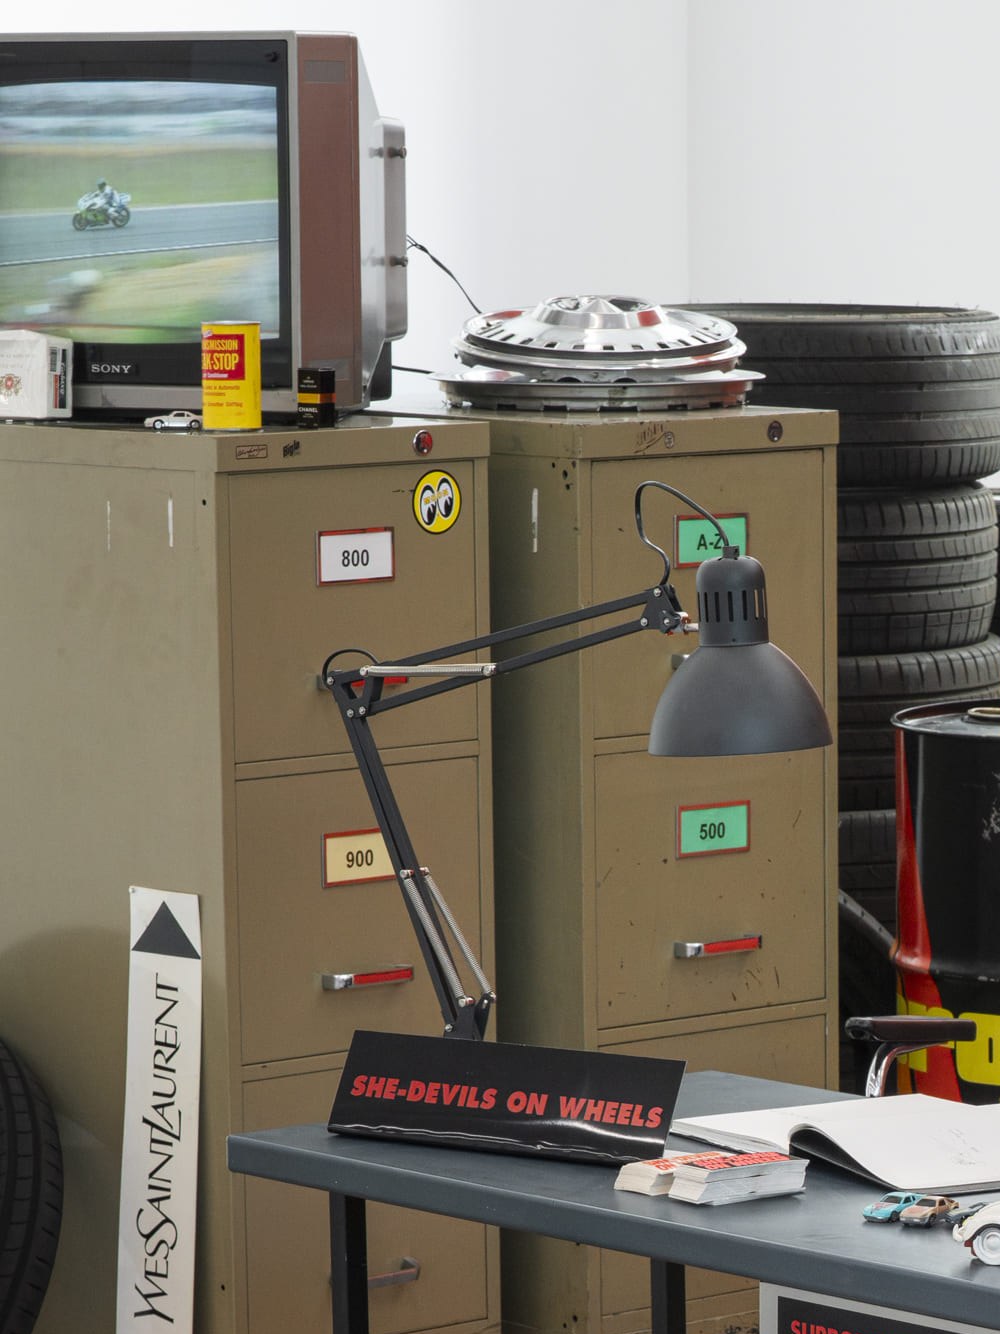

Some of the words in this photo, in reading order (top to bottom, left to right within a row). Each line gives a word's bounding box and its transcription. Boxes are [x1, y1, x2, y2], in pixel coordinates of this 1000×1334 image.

[91, 363, 132, 375] SONY
[341, 549, 370, 567] 800
[699, 821, 727, 841] 500
[345, 849, 375, 869] 900
[350, 1074, 498, 1110] SHE-DEVILS
[507, 1090, 548, 1116] ON
[559, 1096, 664, 1129] WHEELS
